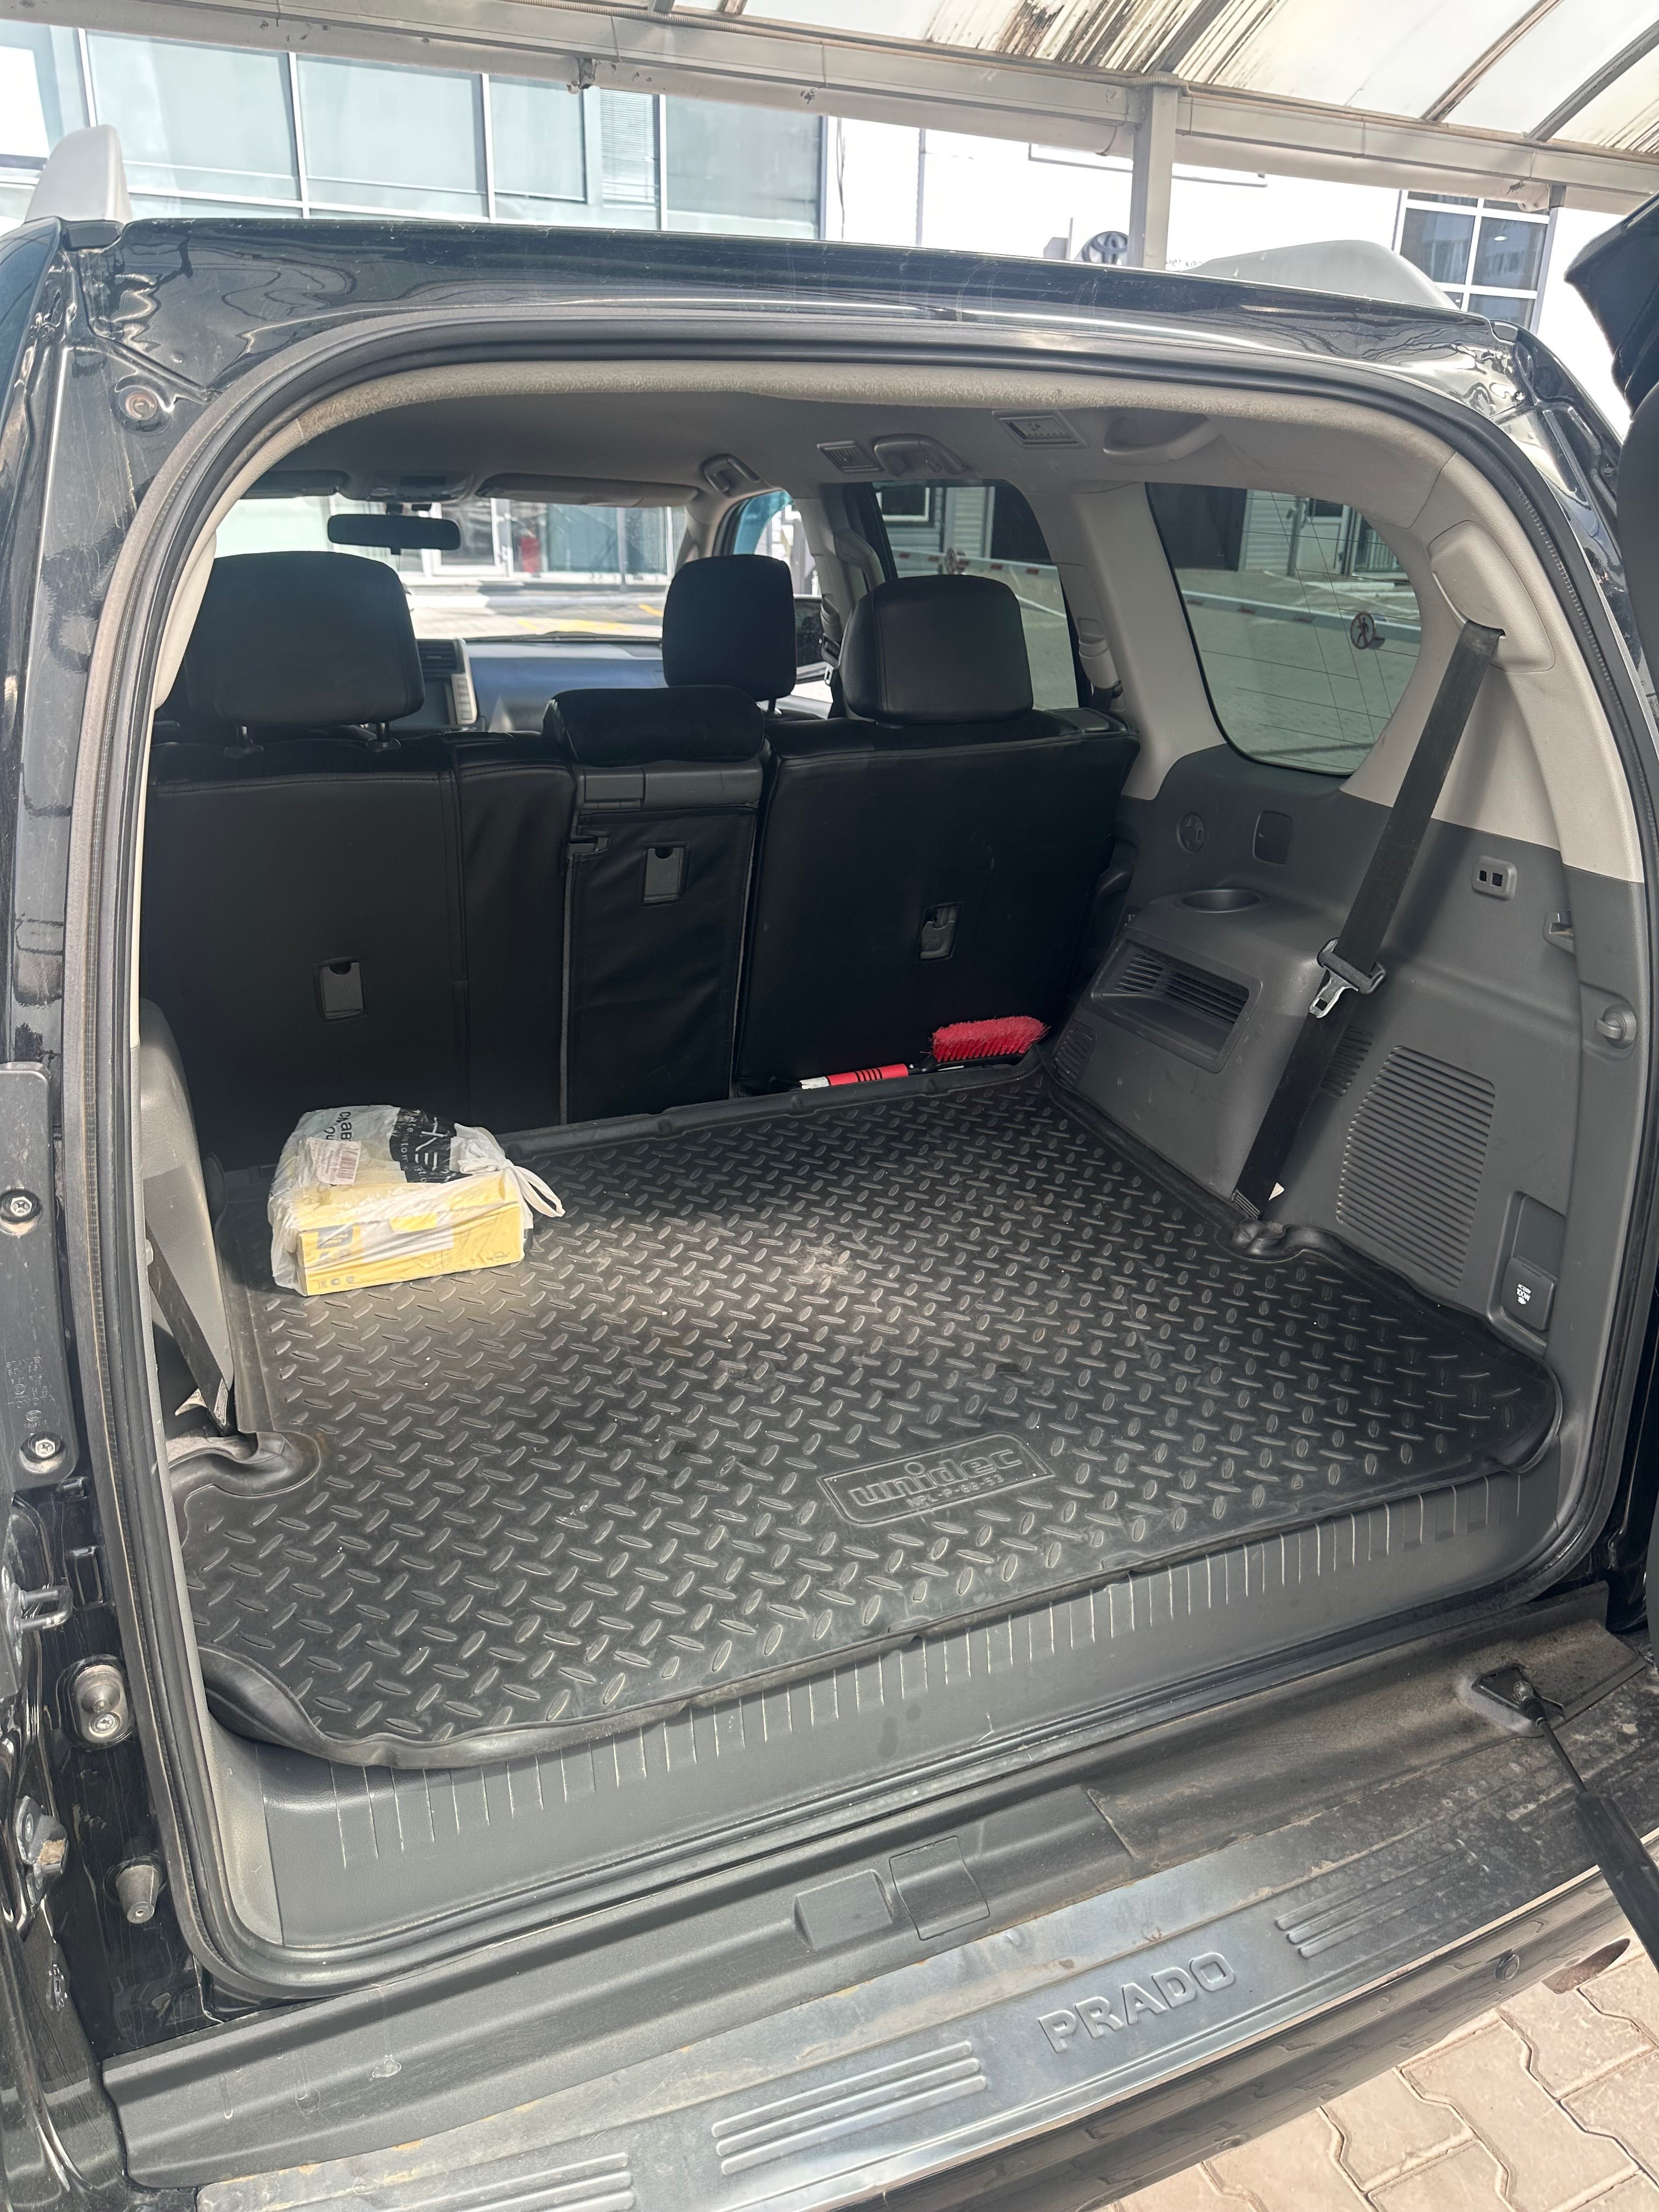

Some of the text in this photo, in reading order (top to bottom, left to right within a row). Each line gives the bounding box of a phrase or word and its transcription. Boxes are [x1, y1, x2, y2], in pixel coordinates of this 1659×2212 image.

[1517, 1288, 1531, 1301] 100W
[848, 1449, 1023, 1506] unidec
[1037, 1951, 1236, 2054] PRADO
